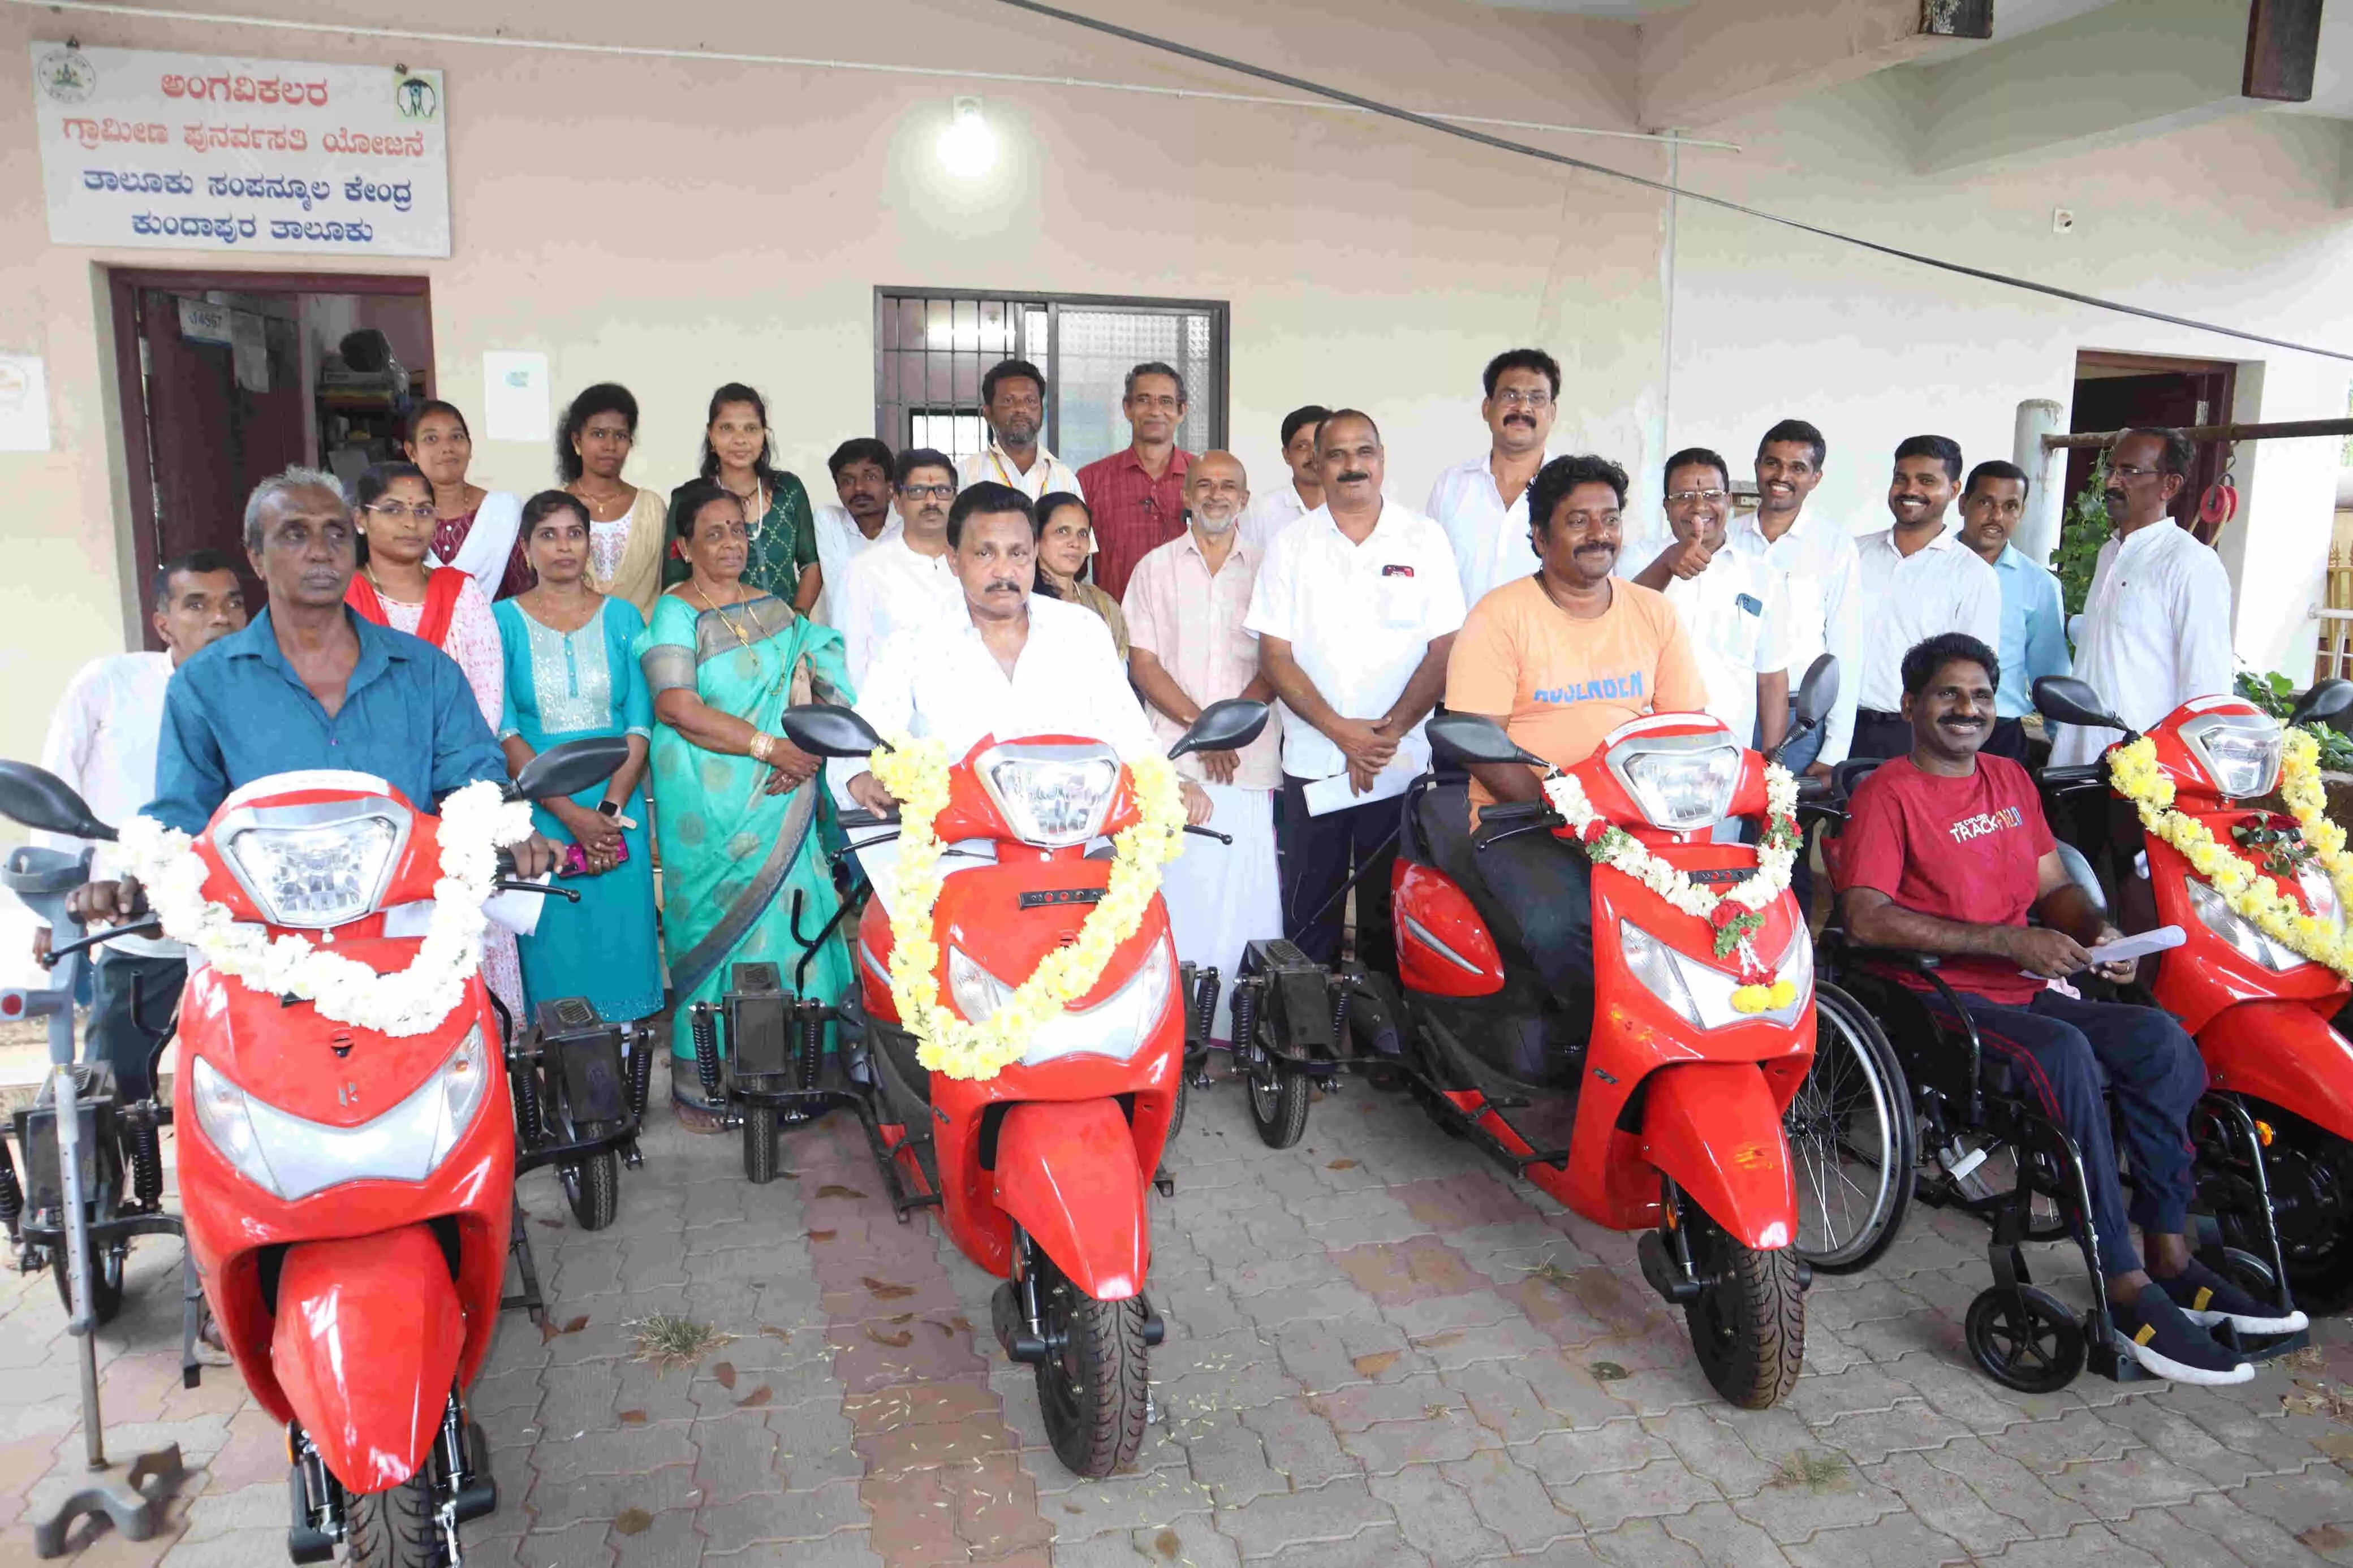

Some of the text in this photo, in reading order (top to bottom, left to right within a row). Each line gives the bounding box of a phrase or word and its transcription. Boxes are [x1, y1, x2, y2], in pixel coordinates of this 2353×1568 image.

[161, 70, 328, 107] ಅಂಗವಿಕಲರ
[62, 117, 168, 150] ಗ್ರಾಮೀಣ
[322, 126, 424, 157] ಯೋಜನೆ
[83, 170, 193, 195] ತಾಲೂಕು
[344, 176, 412, 212] ಕೇಂದ್ರ
[131, 211, 373, 244] ಕುಂದಾಪುರ ತಾಲೂಕು
